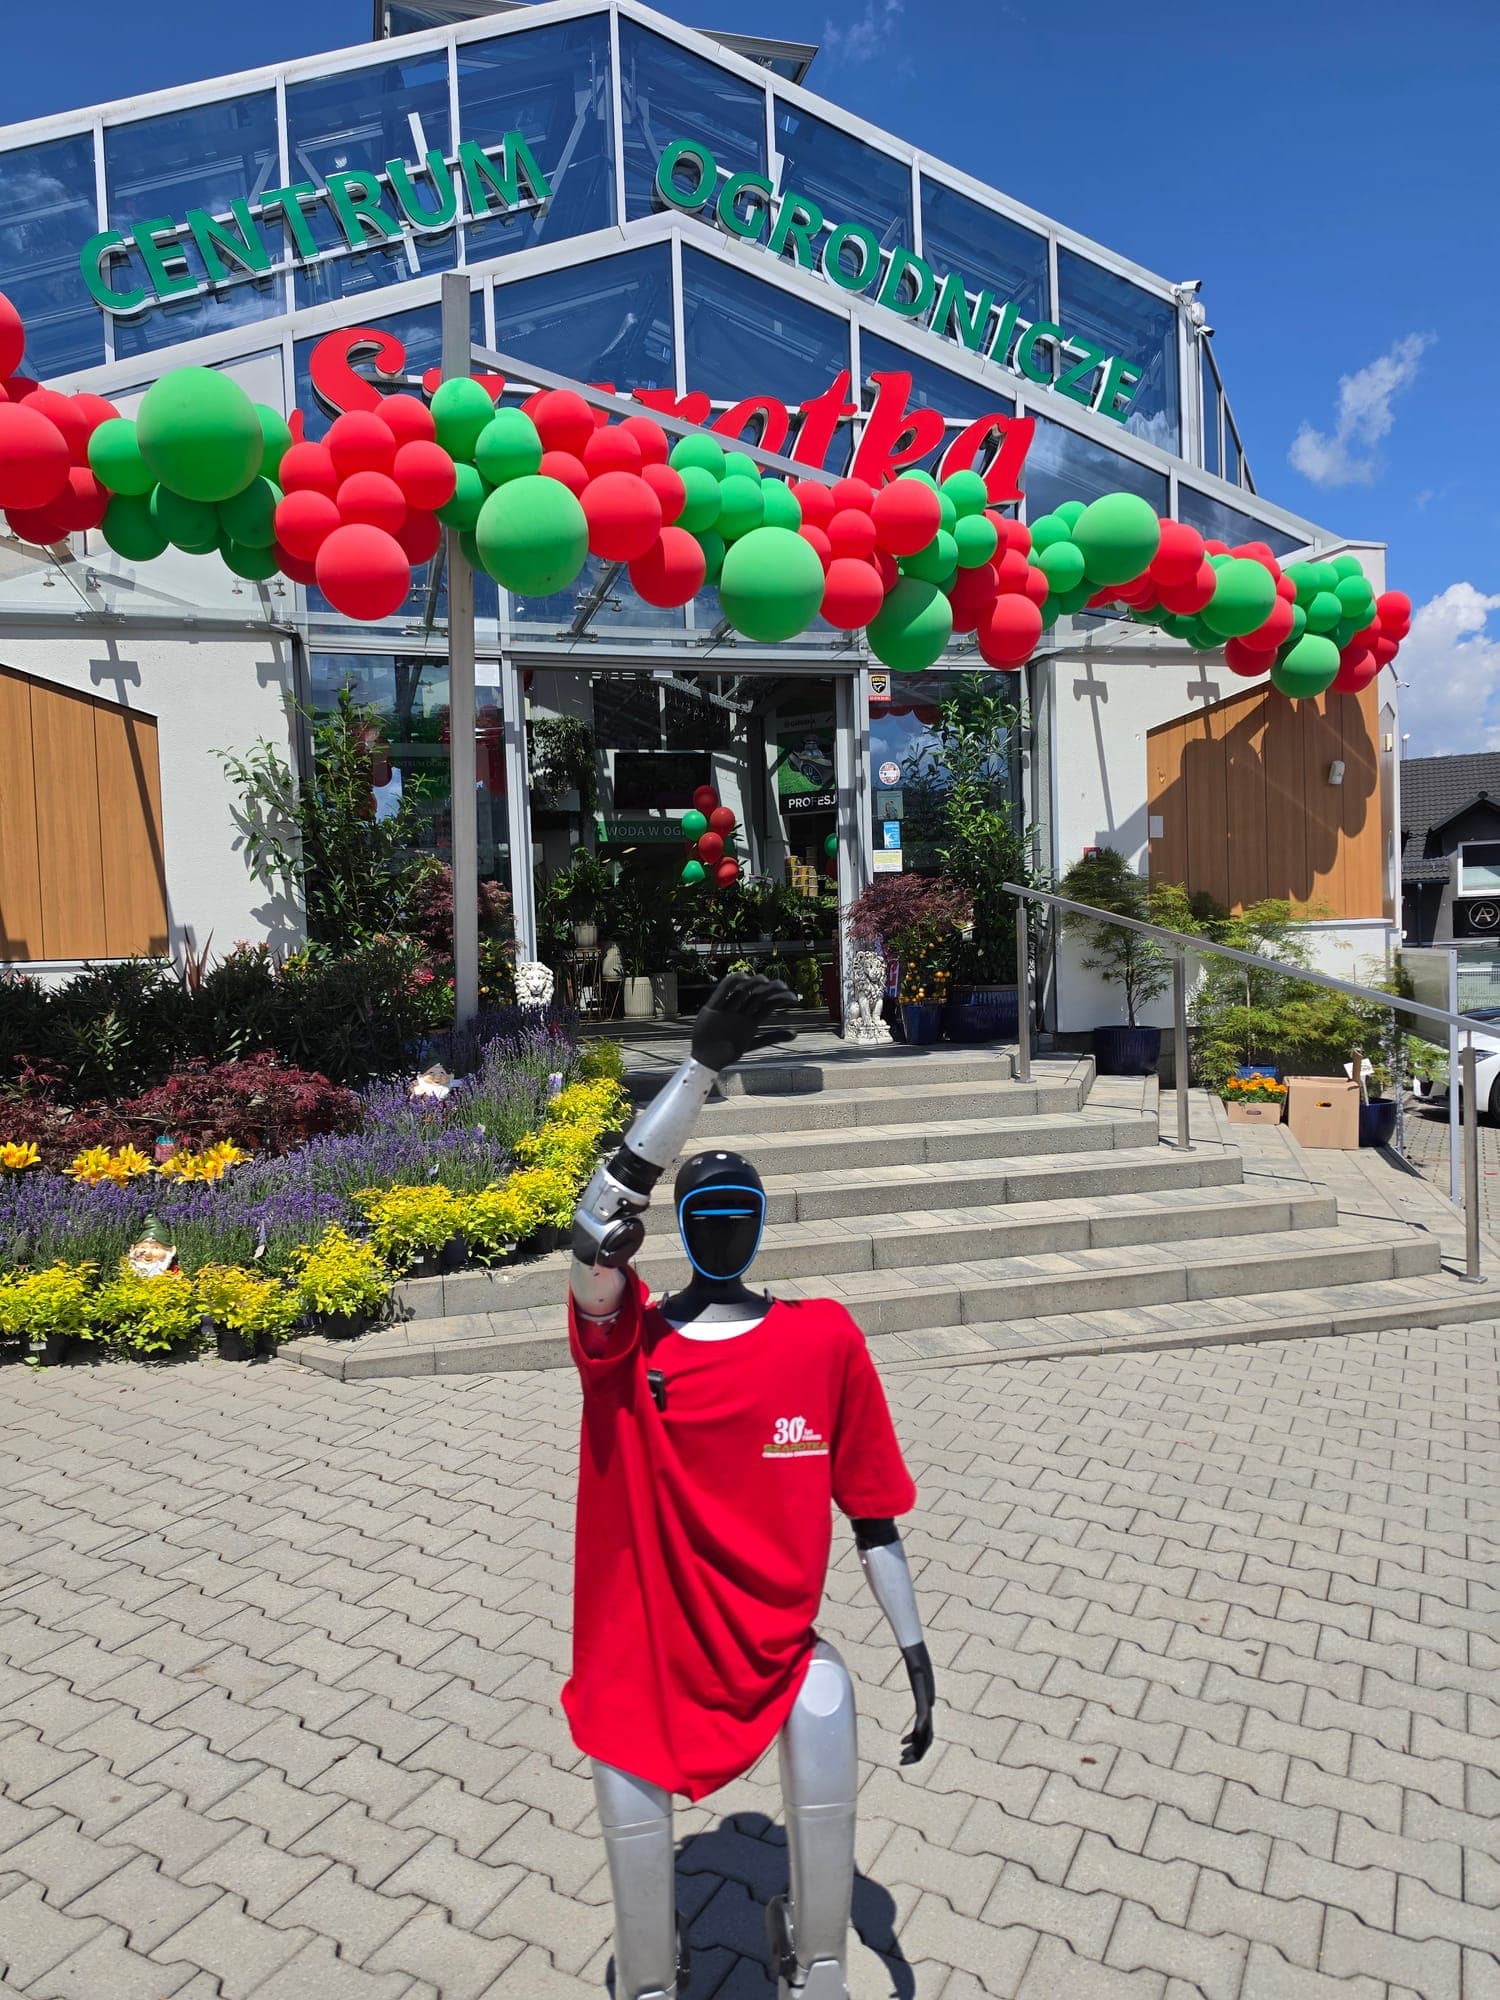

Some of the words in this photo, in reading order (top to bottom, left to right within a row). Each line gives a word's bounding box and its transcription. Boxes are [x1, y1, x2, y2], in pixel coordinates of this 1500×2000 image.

[80, 131, 552, 314] CENTRUM
[655, 138, 1142, 424] OGRODNICZE
[606, 825, 646, 837] WODA
[648, 825, 659, 837] W
[773, 1416, 807, 1444] 30
